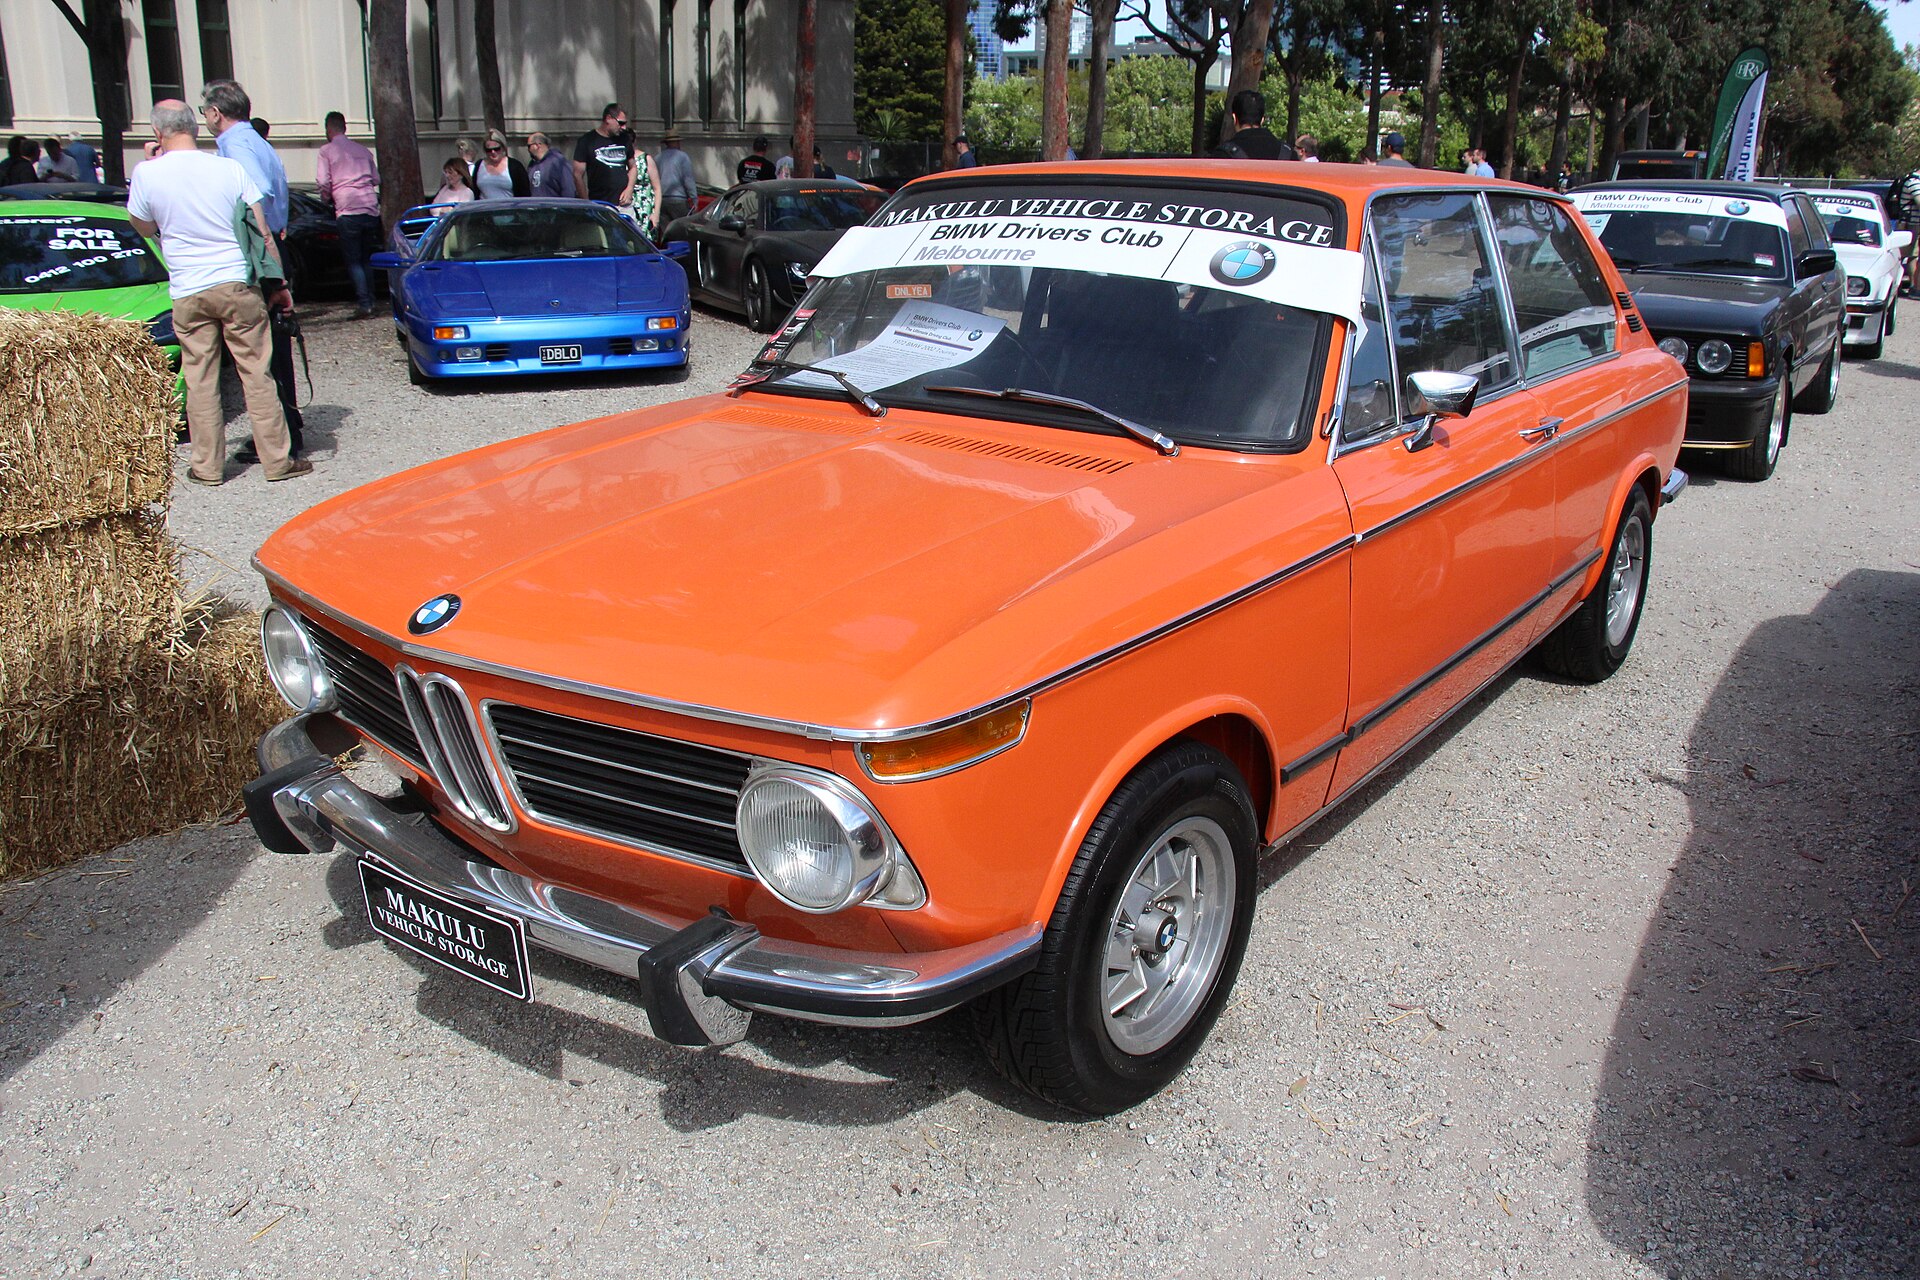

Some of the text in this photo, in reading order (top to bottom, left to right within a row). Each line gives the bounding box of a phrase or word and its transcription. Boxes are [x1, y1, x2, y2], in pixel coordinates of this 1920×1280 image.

[1628, 194, 1671, 202] Drivers
[1675, 196, 1703, 204] Club
[882, 199, 1334, 248] MAKULU VEHICLE STORAGE
[56, 228, 115, 239] FOR
[929, 222, 1164, 248] BMW Drivers Club
[48, 239, 122, 250] SALE
[913, 245, 1036, 261] Melbourne
[24, 248, 146, 284] 0412 100 270
[913, 314, 961, 330] BMW Drivers Club
[546, 347, 578, 360] DBLO
[384, 886, 486, 950] MAKULU
[376, 905, 509, 979] VEHICLE STORAGE
